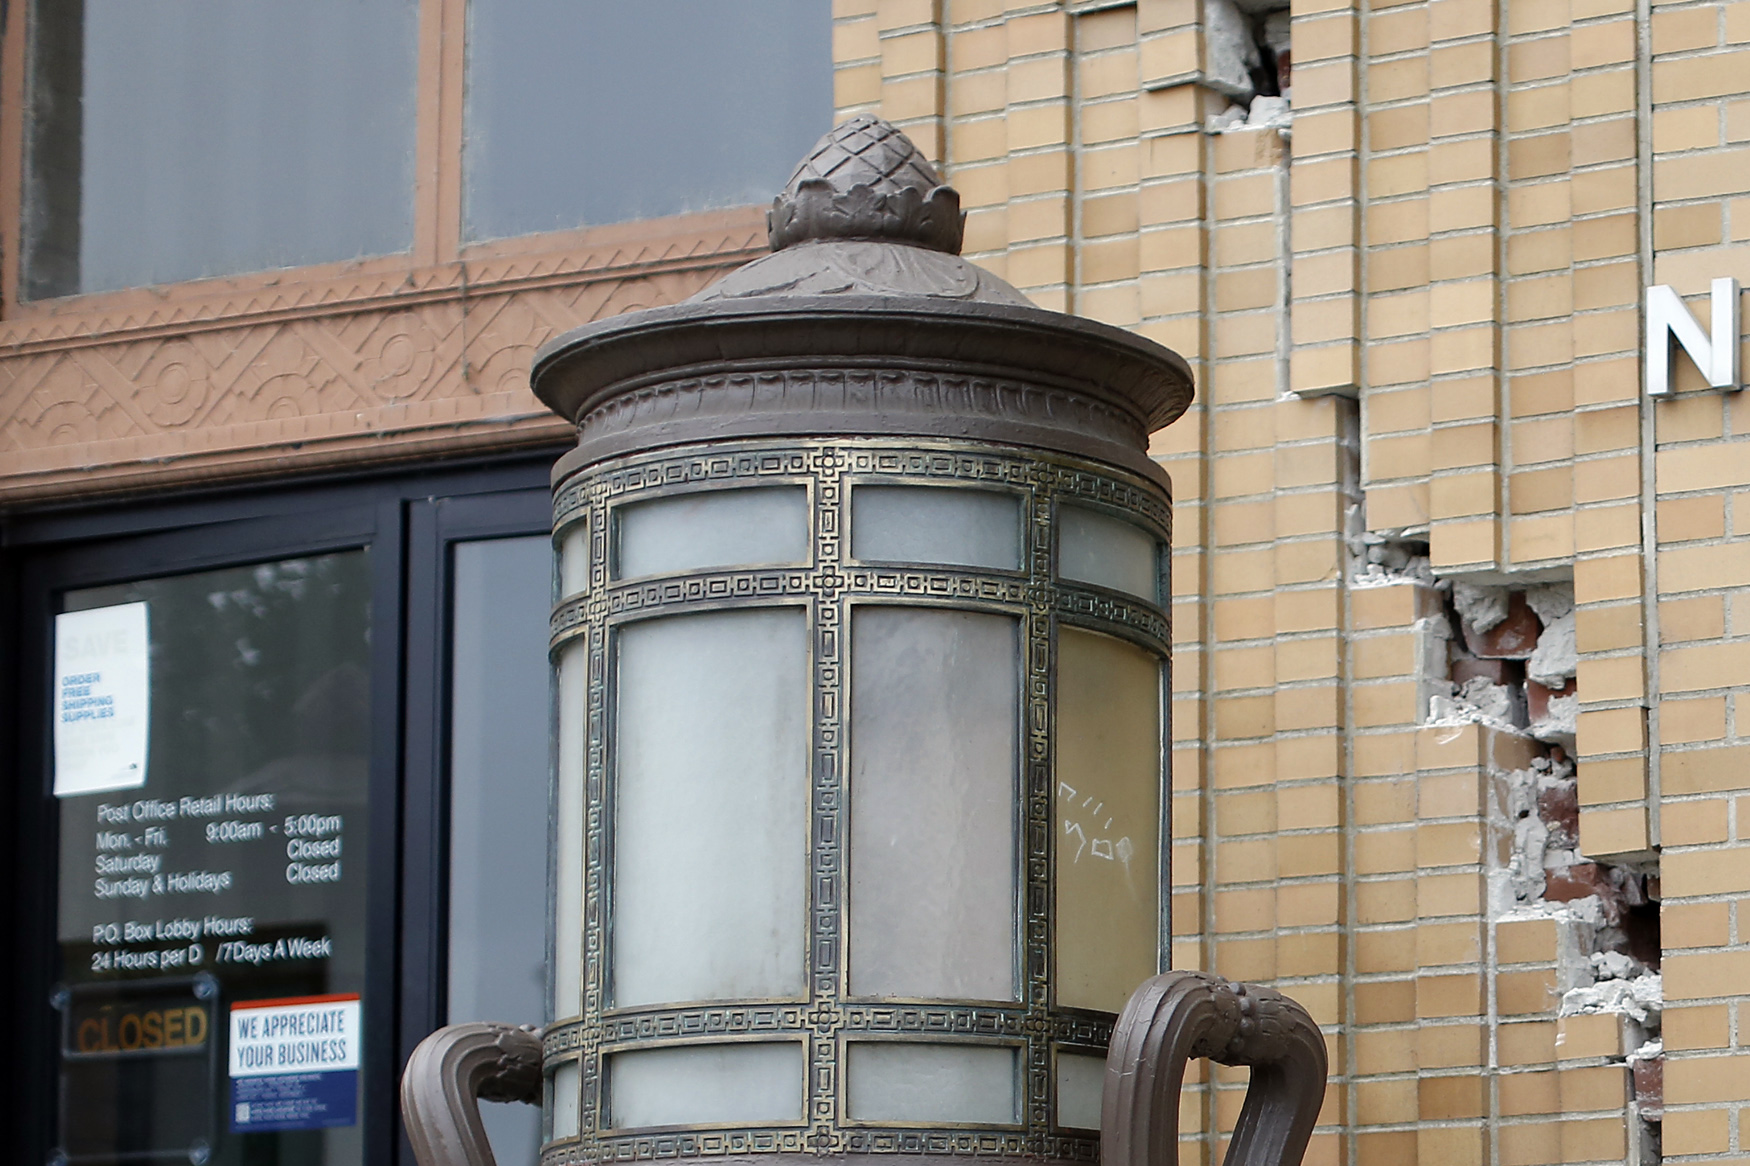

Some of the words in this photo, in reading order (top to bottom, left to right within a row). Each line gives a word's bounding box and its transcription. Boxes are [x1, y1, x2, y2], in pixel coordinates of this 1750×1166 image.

[62, 629, 128, 661] SAVE
[62, 672, 101, 686] ORDER
[62, 685, 91, 698] FREE
[61, 706, 114, 722] SUPPLIES
[62, 695, 114, 710] SHIPPING
[97, 803, 131, 824] Post
[132, 799, 177, 822] Office
[180, 793, 222, 817] Retail
[225, 793, 275, 814] Hours:
[96, 831, 132, 851] Mon.
[145, 826, 169, 848] Fri.
[205, 820, 263, 844] 9:00am
[283, 814, 342, 838] 5:00pm
[95, 853, 161, 875] Saturday
[287, 836, 341, 861] Closed
[94, 876, 150, 900] Sunday
[152, 873, 165, 894] &
[167, 870, 232, 895] Holidays
[286, 860, 341, 885] Closed
[93, 922, 121, 945] P.O.
[124, 921, 154, 943] Box
[156, 918, 201, 942] Lobby
[203, 915, 254, 937] Hours:
[91, 951, 112, 973] 24
[113, 948, 159, 969] Hours
[160, 949, 187, 971] per
[273, 938, 287, 960] A
[287, 935, 332, 959] Week
[78, 1006, 207, 1052] CLOSED
[238, 1015, 257, 1039] WE
[262, 1009, 344, 1038] APPRECIATE
[237, 1044, 273, 1067] YOUR
[278, 1038, 346, 1065] BUSINESS
